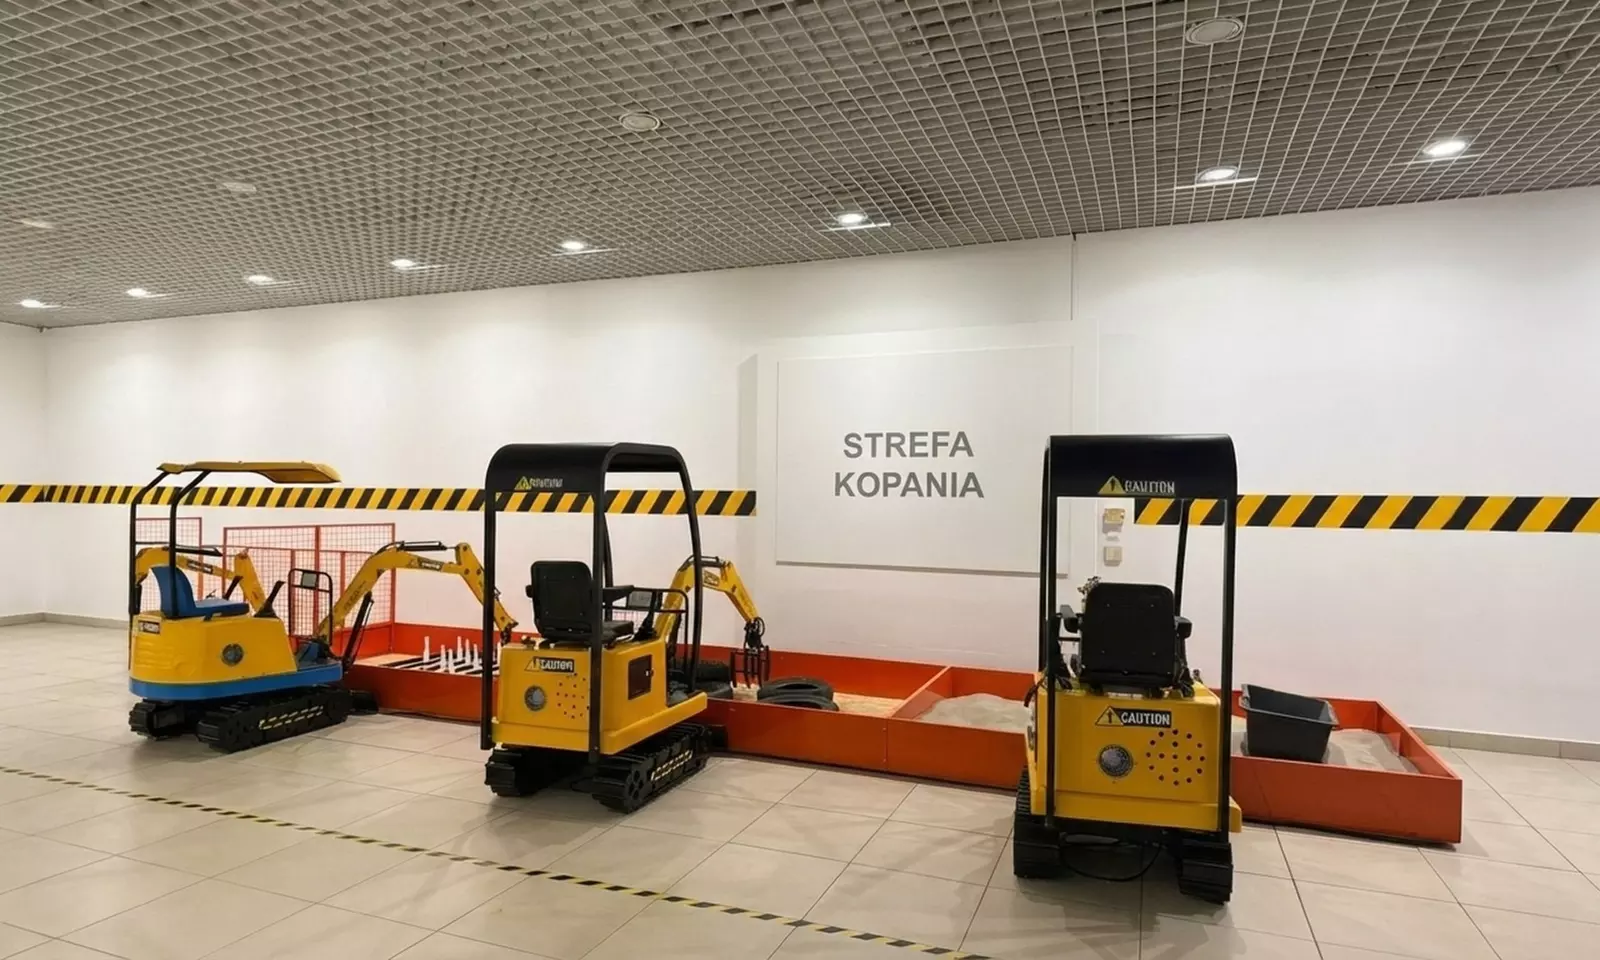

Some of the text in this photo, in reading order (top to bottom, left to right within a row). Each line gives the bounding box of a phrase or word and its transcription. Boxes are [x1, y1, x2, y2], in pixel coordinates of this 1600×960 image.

[843, 431, 974, 458] STREFA
[834, 472, 984, 498] KOPANIA
[1121, 711, 1170, 725] CAUTION
